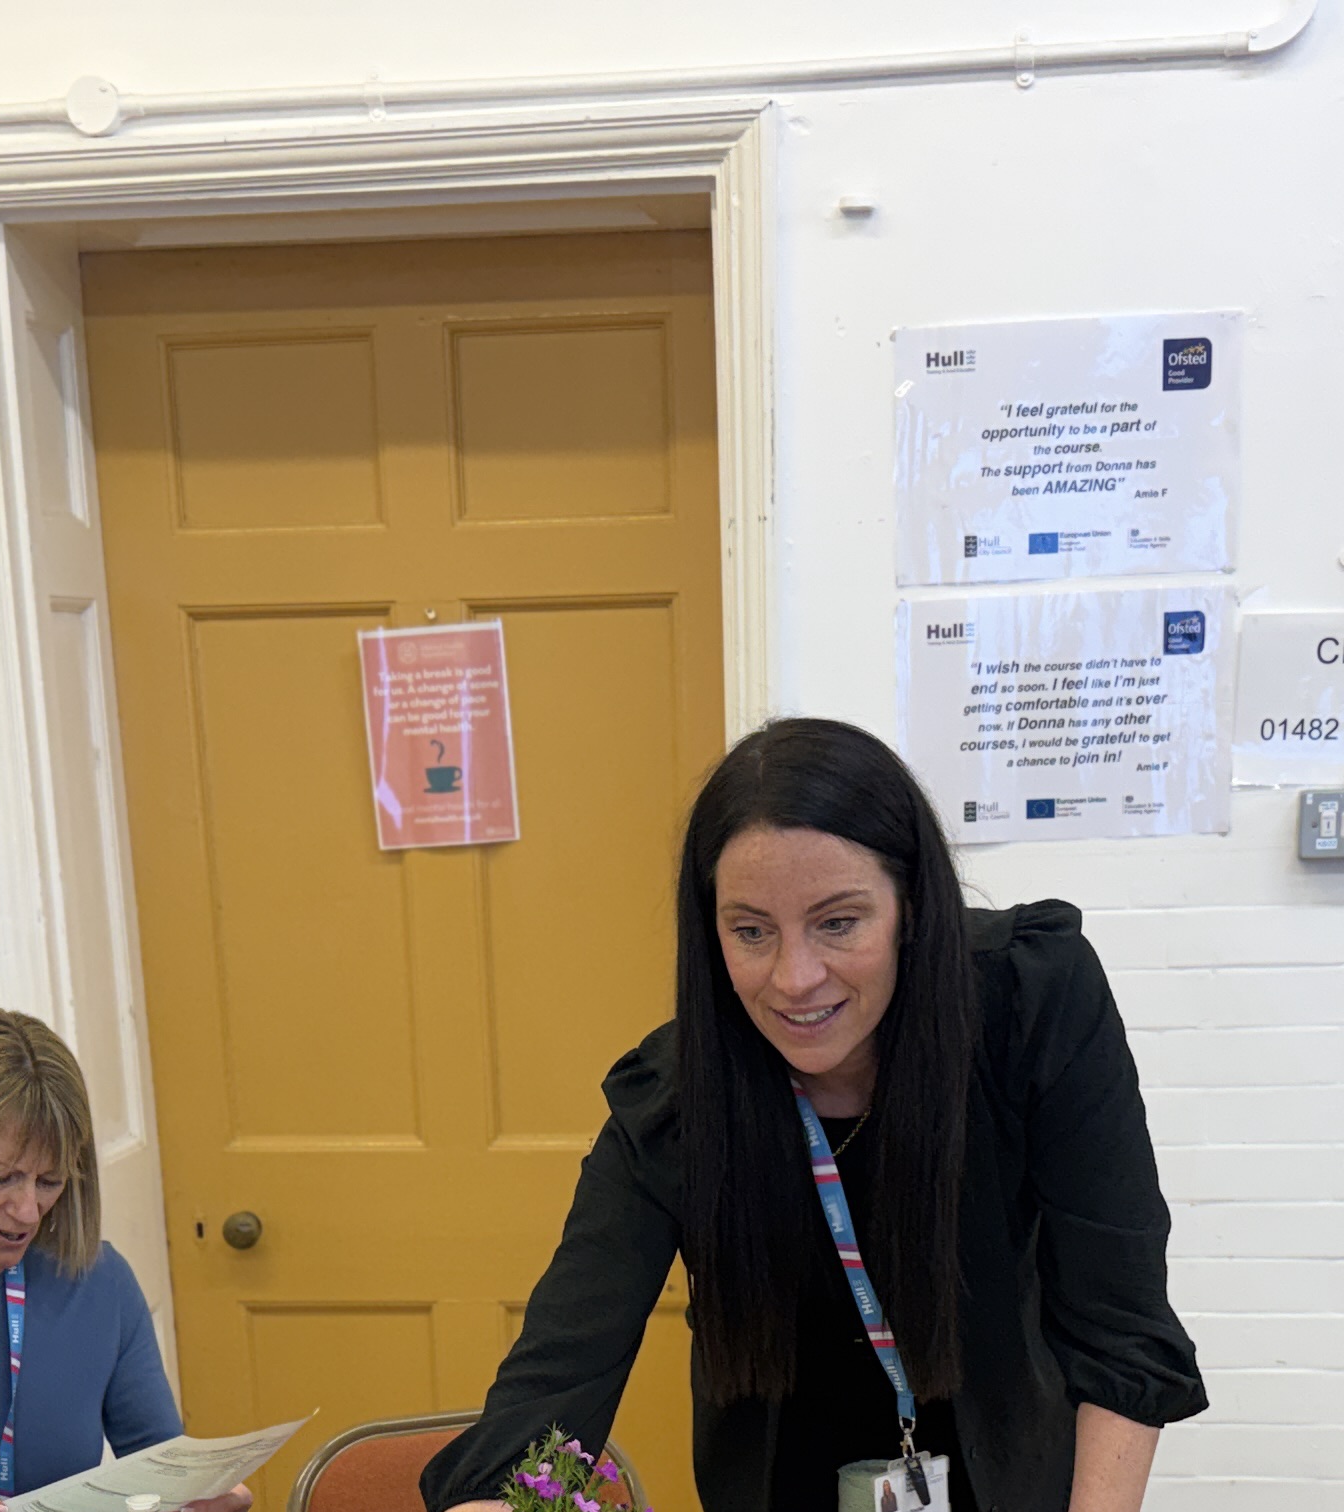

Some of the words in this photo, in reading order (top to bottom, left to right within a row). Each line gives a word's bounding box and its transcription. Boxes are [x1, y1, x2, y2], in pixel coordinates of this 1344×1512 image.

[926, 350, 964, 368] Hull
[1168, 350, 1207, 367] Ofsted
[1016, 402, 1044, 418] feel
[1045, 401, 1098, 420] grateful
[1100, 402, 1117, 414] for
[1119, 401, 1139, 413] the
[981, 422, 1065, 443] opportunity
[1068, 423, 1081, 436] to
[1082, 422, 1097, 435] be
[1099, 425, 1108, 434] a
[1109, 418, 1142, 437] part
[1144, 419, 1158, 432] of
[1033, 444, 1052, 456] the
[1054, 441, 1103, 456] course.
[980, 466, 1002, 478] The
[1003, 460, 1064, 479] support
[1065, 461, 1093, 474] from
[1095, 460, 1133, 473] Donna
[1135, 458, 1157, 471] has
[1011, 484, 1040, 497] been
[1133, 488, 1159, 500] Amie
[1161, 487, 1168, 498] F
[978, 535, 1001, 548] Hull
[926, 622, 964, 640] Hull
[1167, 622, 1202, 635] Ofsted
[422, 667, 453, 679] break
[985, 660, 1020, 675] wish
[1023, 662, 1042, 673] the
[1044, 661, 1083, 672] course
[1120, 656, 1148, 668] have
[1150, 655, 1162, 667] to
[407, 684, 416, 694] A
[416, 682, 455, 695] change
[971, 681, 999, 695] end
[1000, 684, 1015, 694] so
[1017, 683, 1049, 693] soon.
[1052, 677, 1058, 691] I
[1061, 676, 1089, 691] feel
[1091, 678, 1111, 689] like
[1138, 676, 1160, 689] just
[409, 697, 447, 710] change
[963, 702, 1003, 717] getting
[1005, 696, 1089, 712] comfortable
[1091, 696, 1113, 708] and
[1135, 693, 1168, 706] over
[421, 708, 448, 725] good
[977, 722, 1004, 733] now.
[1006, 719, 1016, 731] If
[1017, 717, 1066, 731] Donna
[1067, 717, 1088, 728] has
[1090, 717, 1112, 730] any
[1114, 712, 1153, 726] other
[1260, 717, 1340, 741] 01482
[959, 739, 1019, 752] courses,
[1021, 738, 1027, 749] I
[1028, 736, 1063, 749] would
[1064, 736, 1079, 747] be
[1081, 730, 1136, 749] grateful
[1138, 732, 1150, 743] to
[1152, 731, 1172, 745] get
[1006, 759, 1014, 768] a
[1016, 756, 1057, 768] chance
[1059, 755, 1071, 766] to
[1072, 751, 1100, 768] join
[1103, 750, 1123, 764] in!
[1136, 762, 1160, 772] Amie
[1162, 761, 1169, 771] F
[978, 801, 999, 812] Hull
[854, 1286, 875, 1316] Hull
[11, 1319, 20, 1344] Hull
[885, 1365, 904, 1392] Hull
[0, 1457, 9, 1482] Hull
